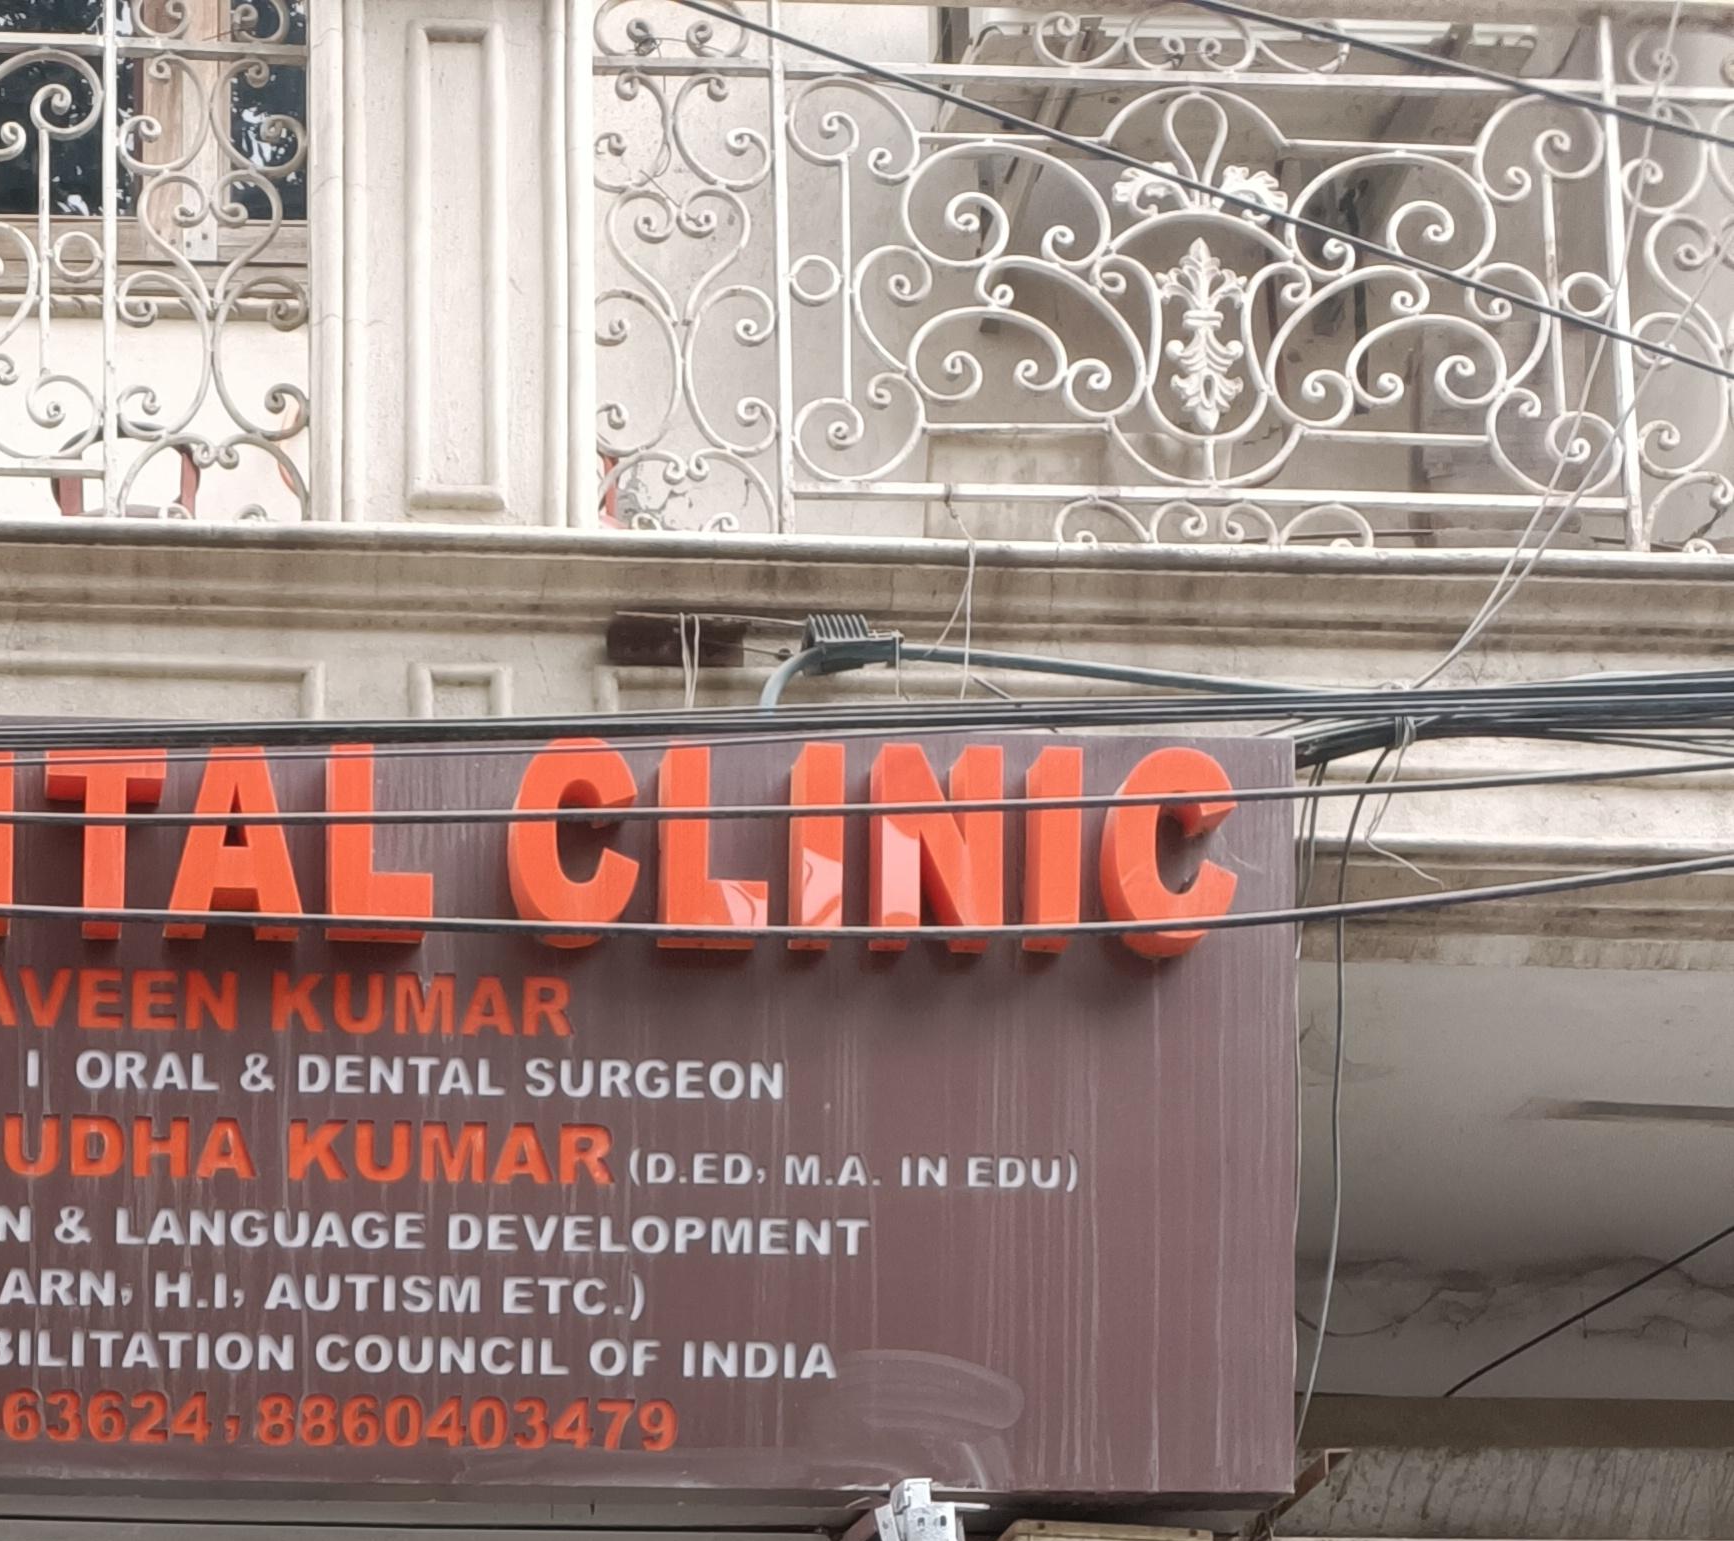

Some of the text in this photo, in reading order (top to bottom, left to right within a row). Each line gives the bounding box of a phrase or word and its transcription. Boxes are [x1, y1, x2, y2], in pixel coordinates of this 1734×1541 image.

[508, 736, 1240, 960] CLINIC
[271, 973, 574, 1038] KUMAR
[76, 1050, 219, 1093] ORAL
[240, 1055, 275, 1094] &
[297, 1056, 506, 1097] DENTAL
[525, 1060, 785, 1101] SURGEON
[286, 1119, 614, 1185] KUMAR
[782, 1153, 883, 1187] M.A.
[900, 1156, 949, 1188] IN
[966, 1154, 1081, 1193] EDU)
[54, 1204, 92, 1244] &
[115, 1209, 426, 1250] LANGUAGE
[448, 1215, 870, 1256] DEVELOPMENT
[264, 1274, 482, 1314] AUTISM
[502, 1276, 648, 1321] ETC.)
[314, 1336, 569, 1376] COUNCIL
[587, 1340, 661, 1378] OF
[681, 1343, 839, 1382] INDIA
[256, 1392, 679, 1450] 8860403479
